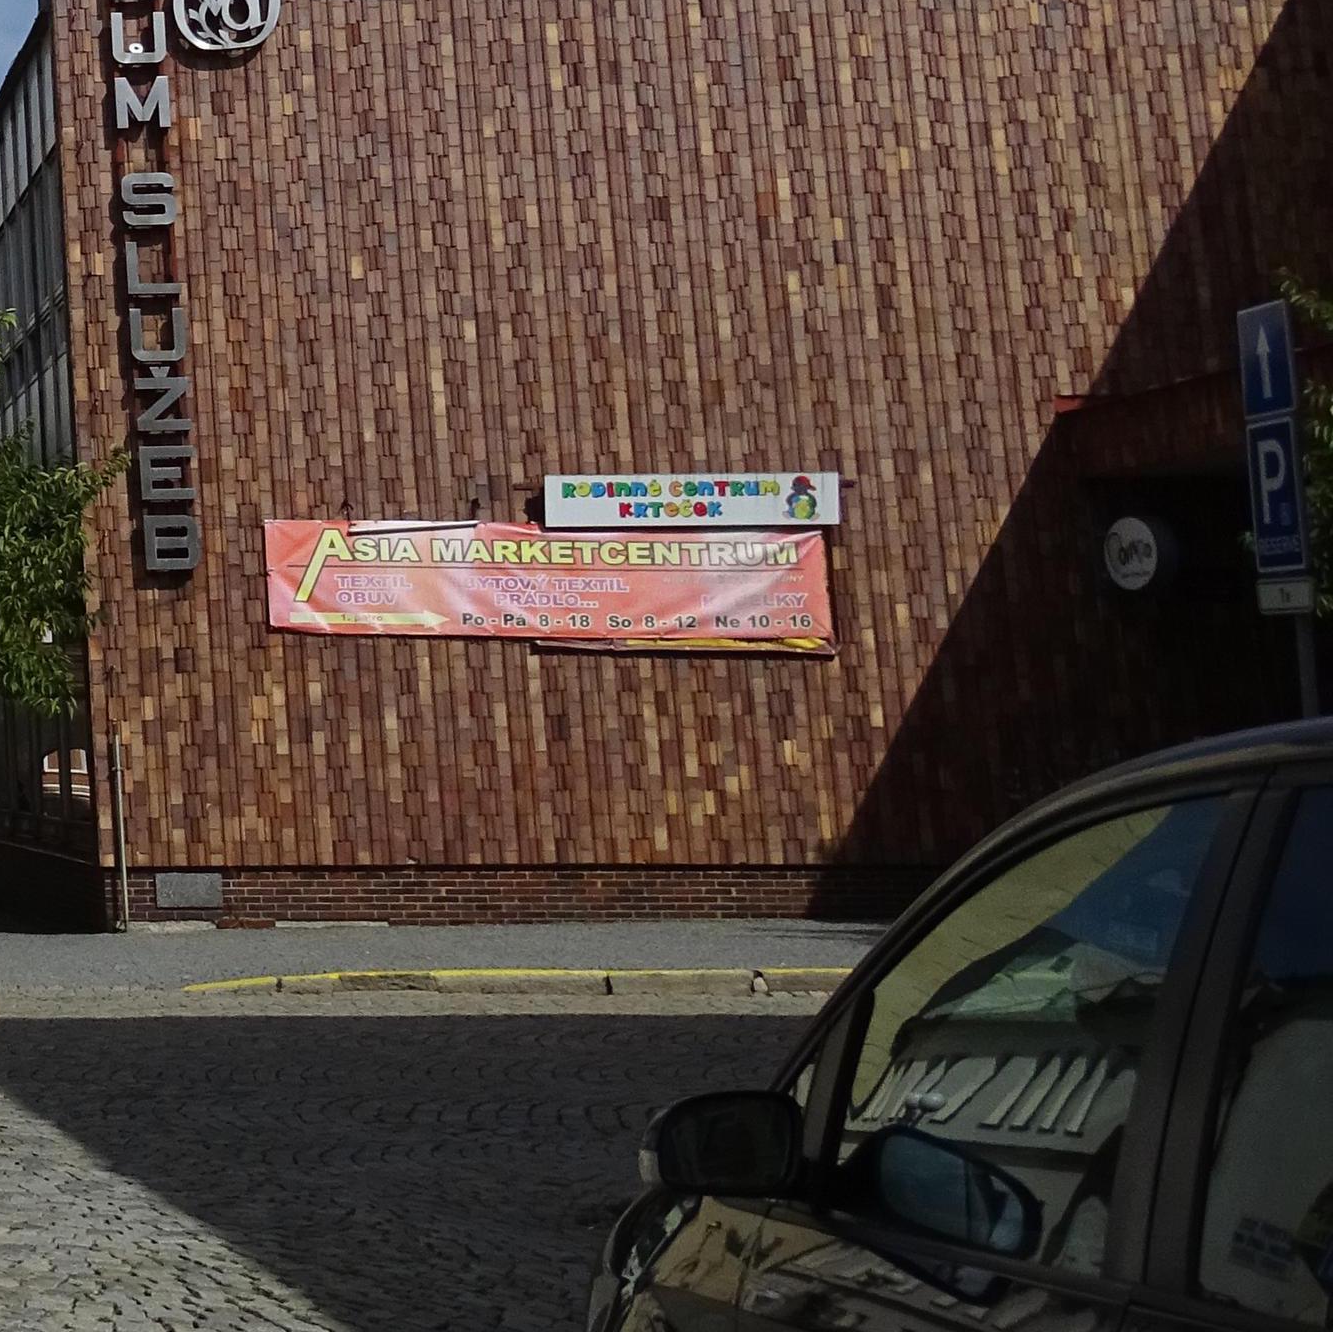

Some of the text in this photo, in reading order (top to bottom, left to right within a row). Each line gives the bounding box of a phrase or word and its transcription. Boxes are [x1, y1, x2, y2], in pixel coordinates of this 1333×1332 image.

[121, 172, 201, 571] SLUŽEB
[1258, 438, 1286, 526] P
[294, 528, 799, 602] ASIA MARKETCENTRUM
[336, 574, 412, 589] TEXTIL
[465, 574, 630, 592] BYTOVÝ TEXTIL
[337, 591, 398, 605] OBUV
[462, 612, 485, 626] Po
[503, 613, 527, 626] Pá
[539, 615, 549, 627] 8
[569, 615, 590, 627] 18
[608, 615, 632, 627] So
[644, 616, 655, 628] 8
[674, 616, 697, 628] 12
[715, 615, 740, 628] Ne
[750, 615, 770, 628] 10
[789, 615, 811, 628] 16
